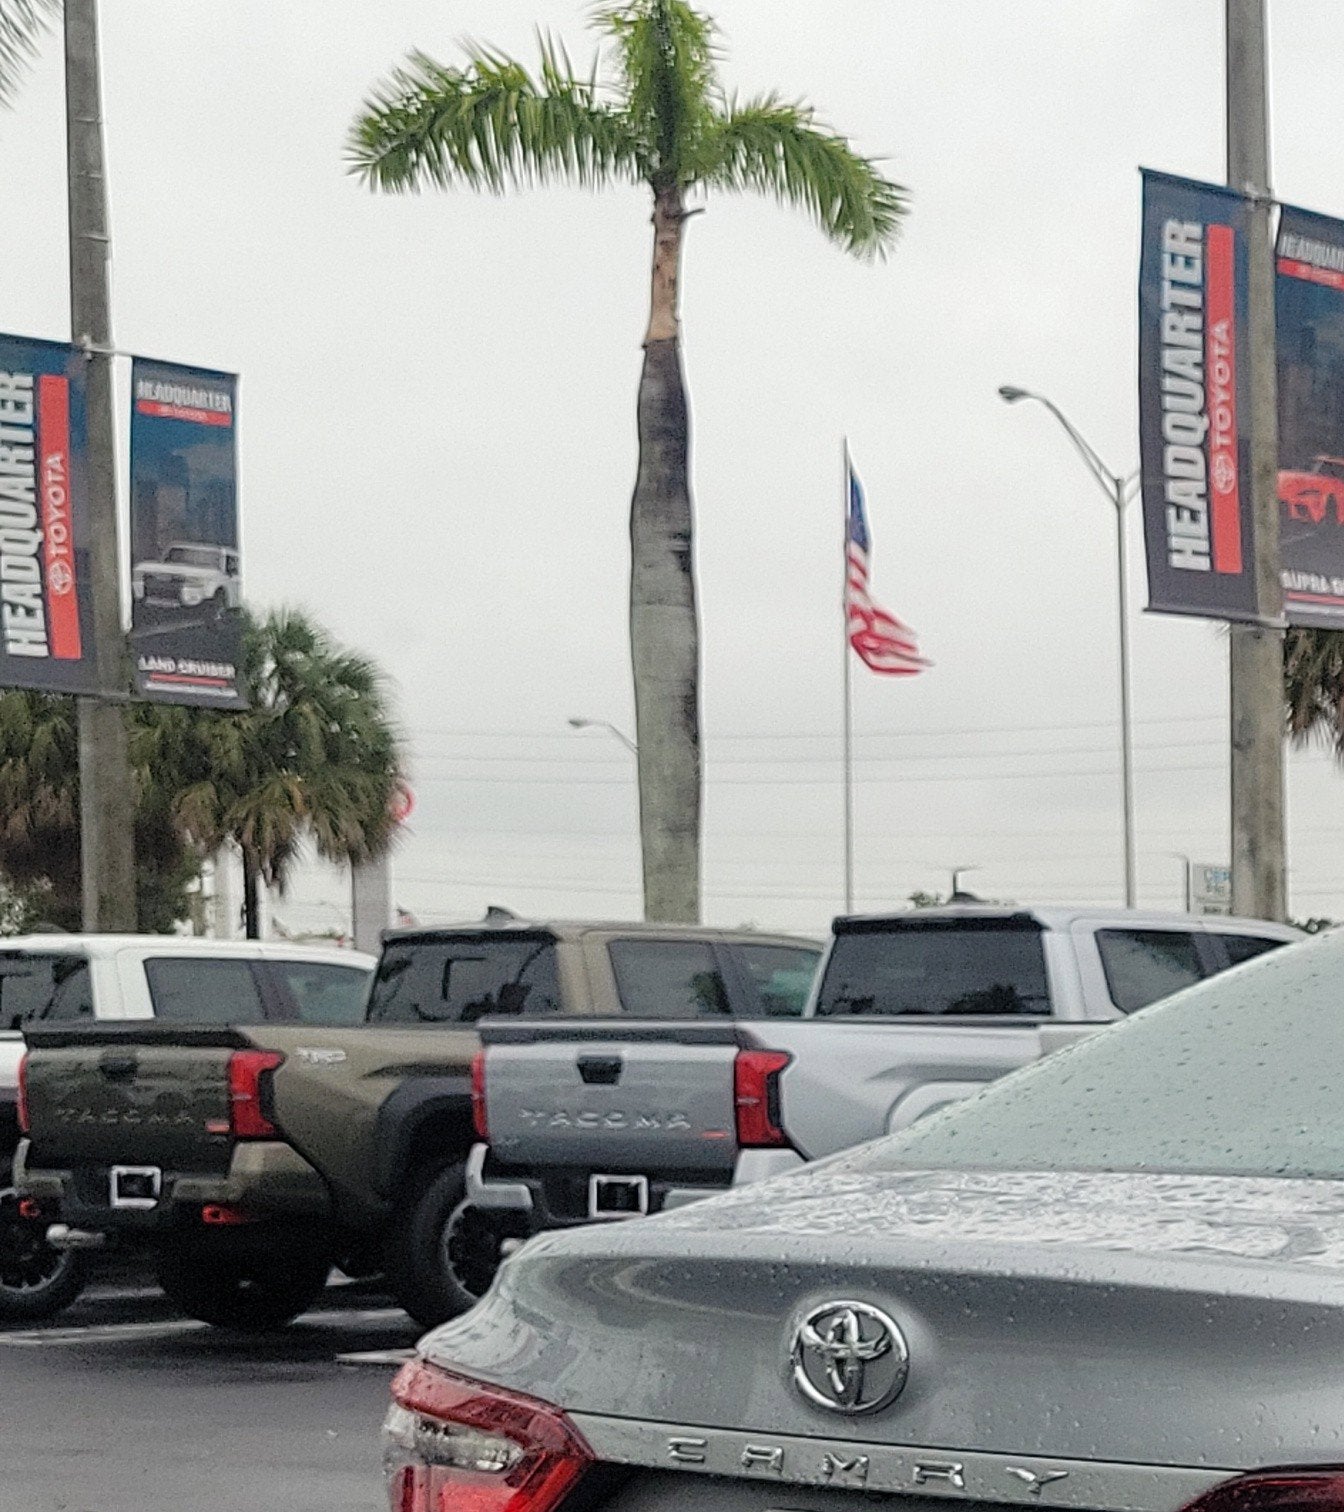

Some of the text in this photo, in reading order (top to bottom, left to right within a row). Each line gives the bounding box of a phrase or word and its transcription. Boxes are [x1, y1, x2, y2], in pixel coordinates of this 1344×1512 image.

[1161, 219, 1213, 572] HEADQUARTER
[1209, 320, 1232, 447] TOYOTA
[46, 453, 68, 556] TOYOTA
[55, 1108, 196, 1125] TACOMA
[518, 1108, 691, 1129] TACOMA
[667, 1436, 1070, 1495] CAMRY
